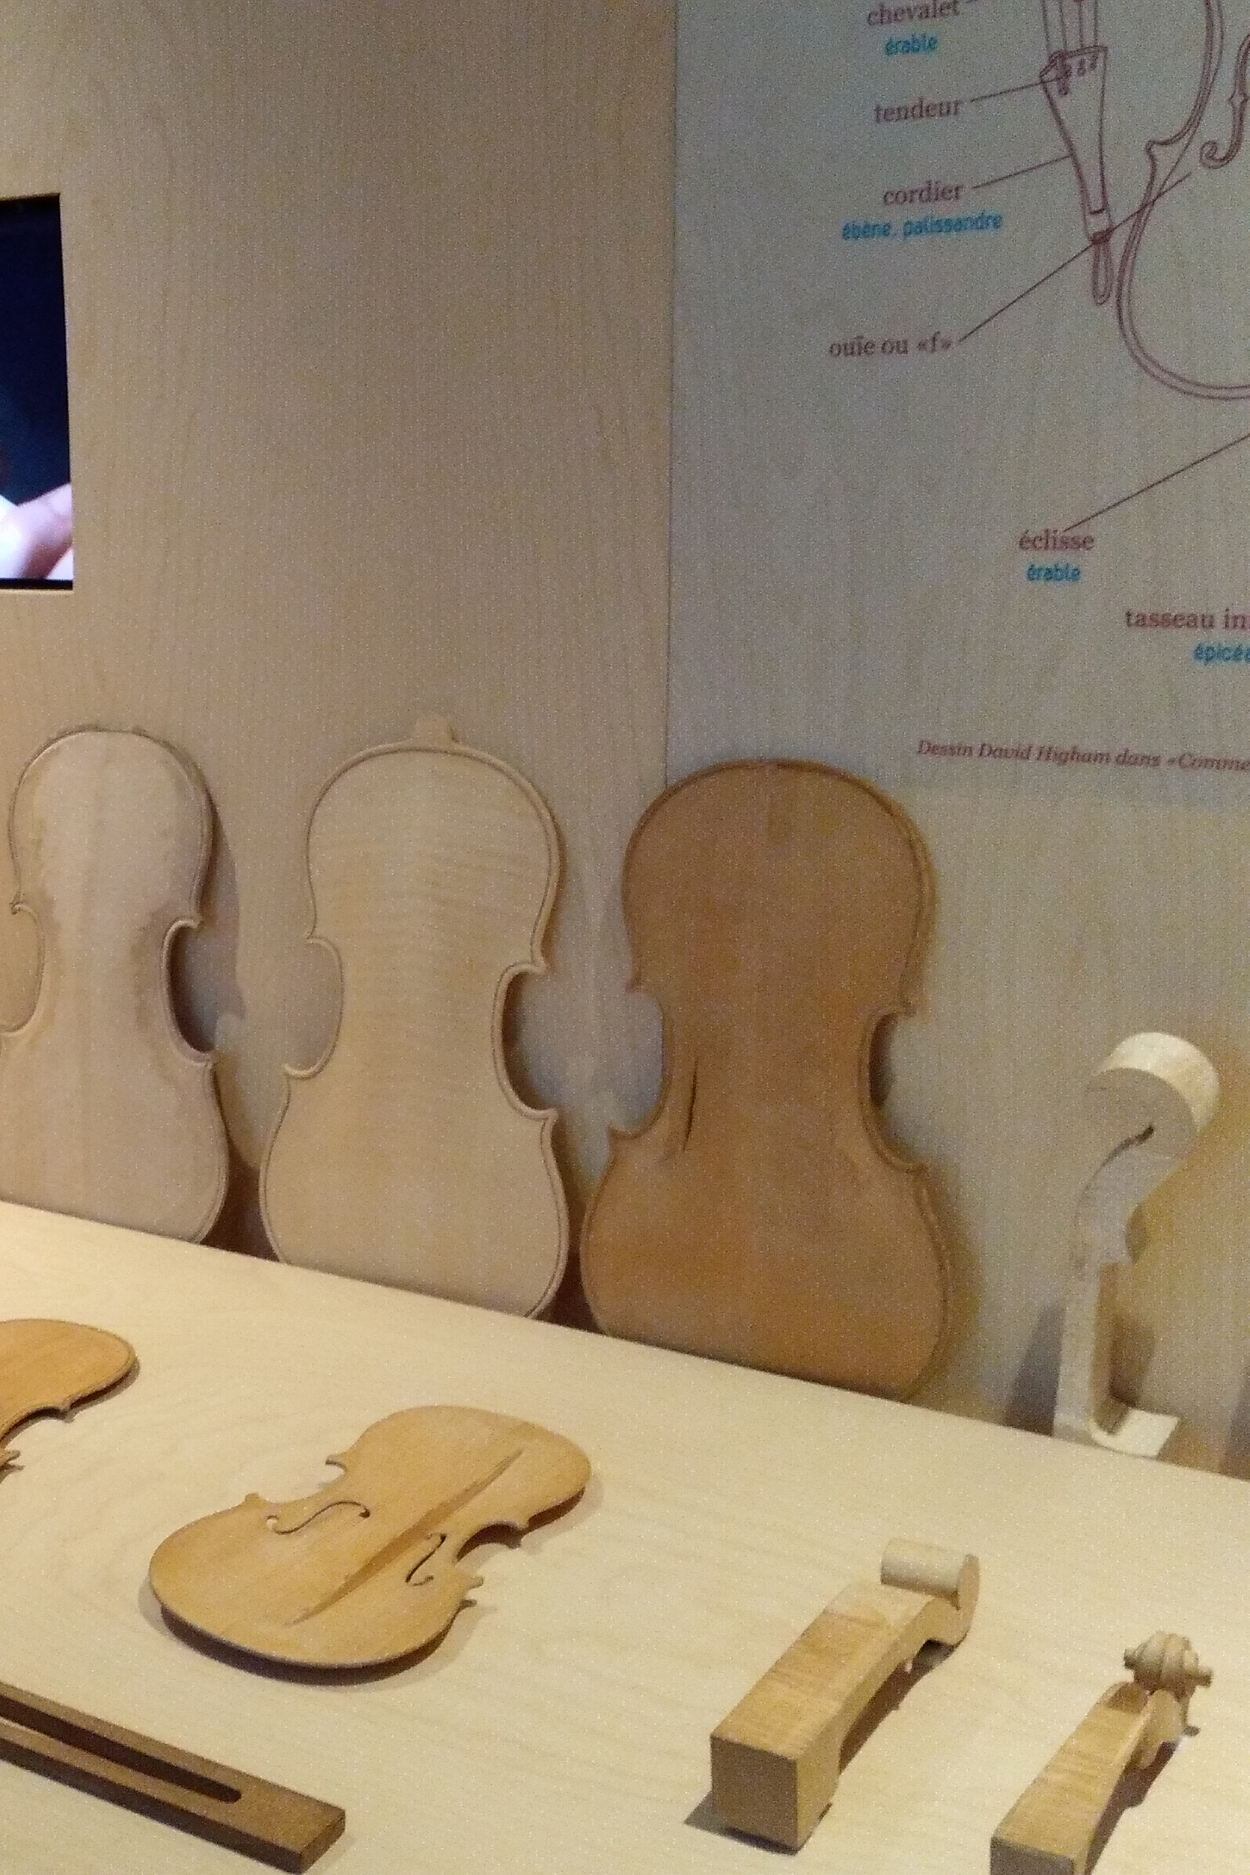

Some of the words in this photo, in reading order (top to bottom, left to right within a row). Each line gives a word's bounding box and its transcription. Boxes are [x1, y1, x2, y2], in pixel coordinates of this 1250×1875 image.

[866, 0, 960, 26] chevalet
[884, 33, 939, 57] érable
[874, 97, 964, 124] tendeur
[882, 179, 965, 206] cordier
[903, 210, 1003, 241] palissandre
[881, 339, 909, 354] ou
[1018, 529, 1095, 550] éclisse
[1026, 563, 1081, 581] érable
[1125, 610, 1215, 629] tasseau
[1224, 607, 1250, 629] in
[917, 740, 973, 757] Dessin
[978, 742, 1032, 760] David
[1115, 748, 1161, 767] dans
